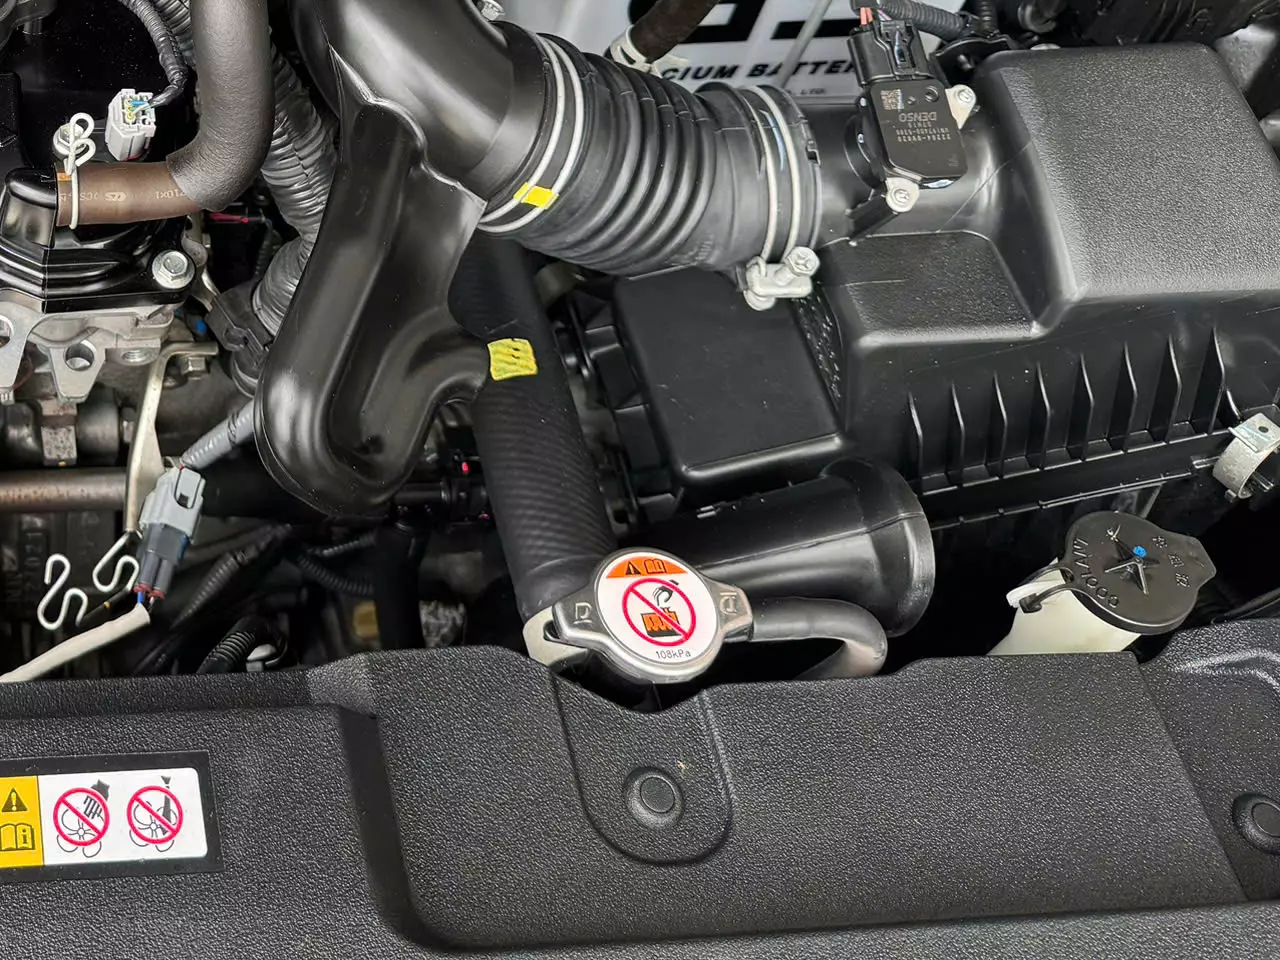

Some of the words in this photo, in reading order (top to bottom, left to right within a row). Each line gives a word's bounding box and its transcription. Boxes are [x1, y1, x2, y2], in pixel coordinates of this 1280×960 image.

[660, 64, 741, 80] CIUM
[898, 111, 937, 122] DENSO
[655, 648, 692, 660] 108kPa
